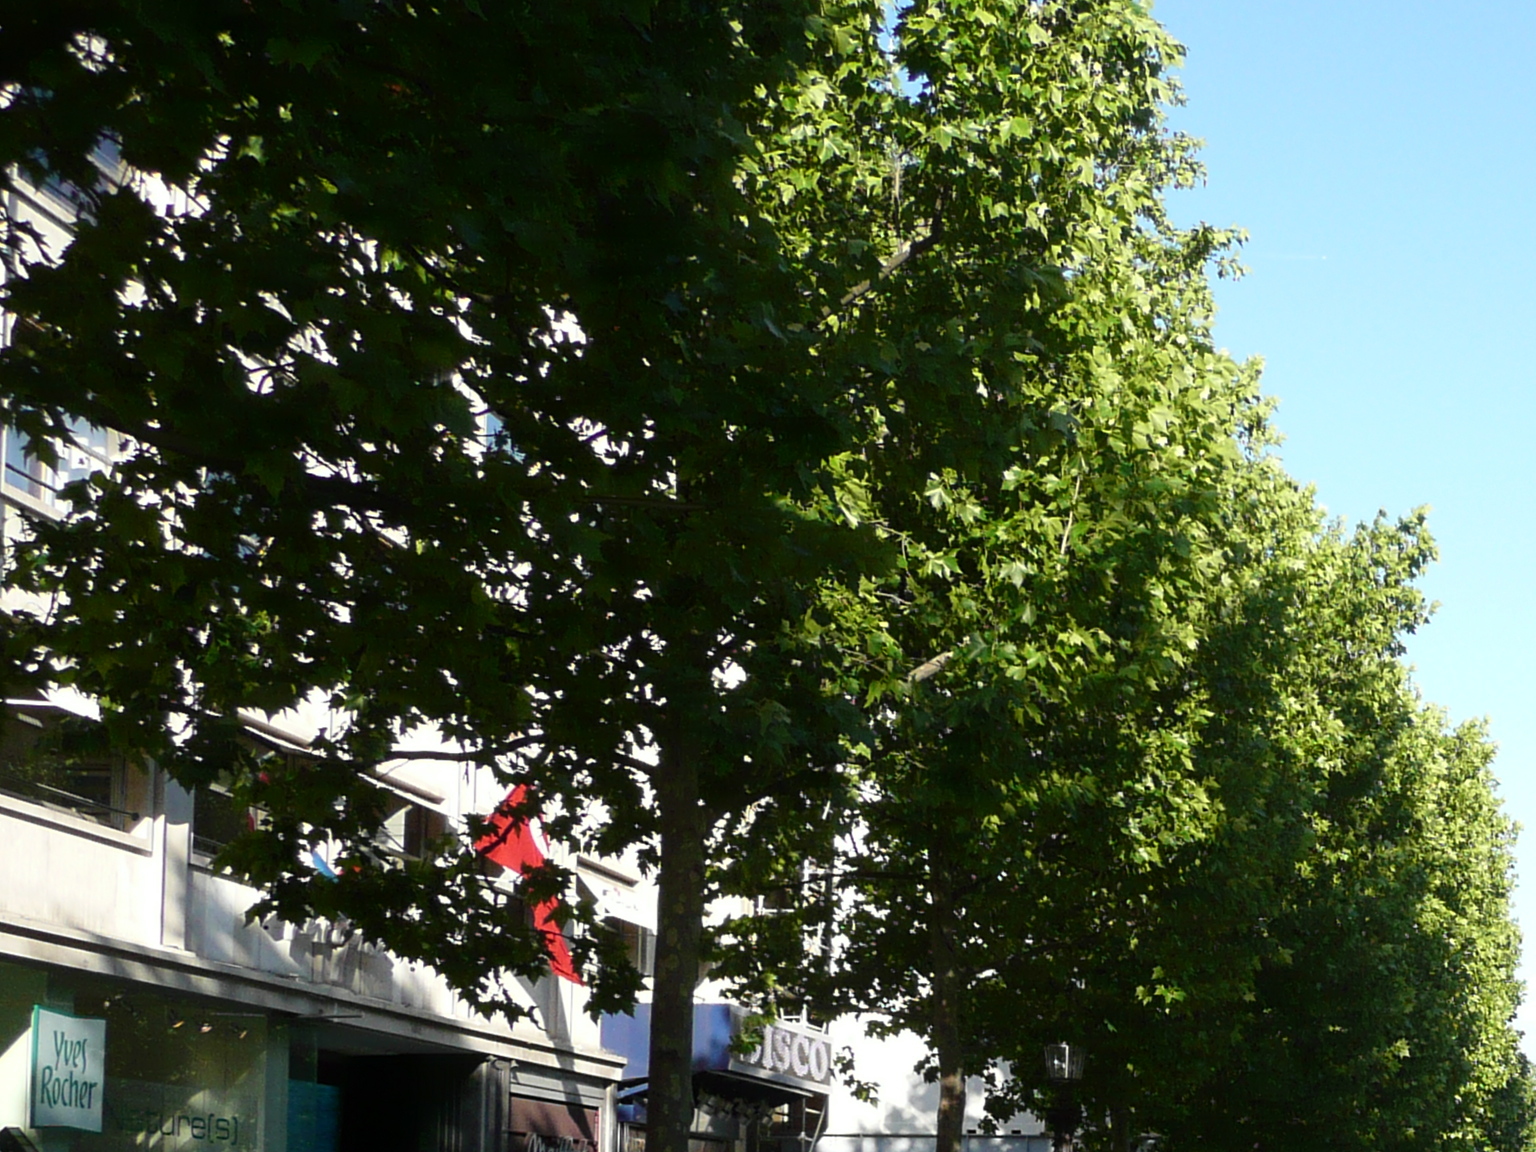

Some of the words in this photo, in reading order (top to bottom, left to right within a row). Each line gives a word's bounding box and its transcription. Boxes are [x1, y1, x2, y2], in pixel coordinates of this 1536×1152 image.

[53, 1030, 88, 1074] Yves
[739, 1023, 829, 1082] ISCO
[40, 1065, 98, 1110] Rocher
